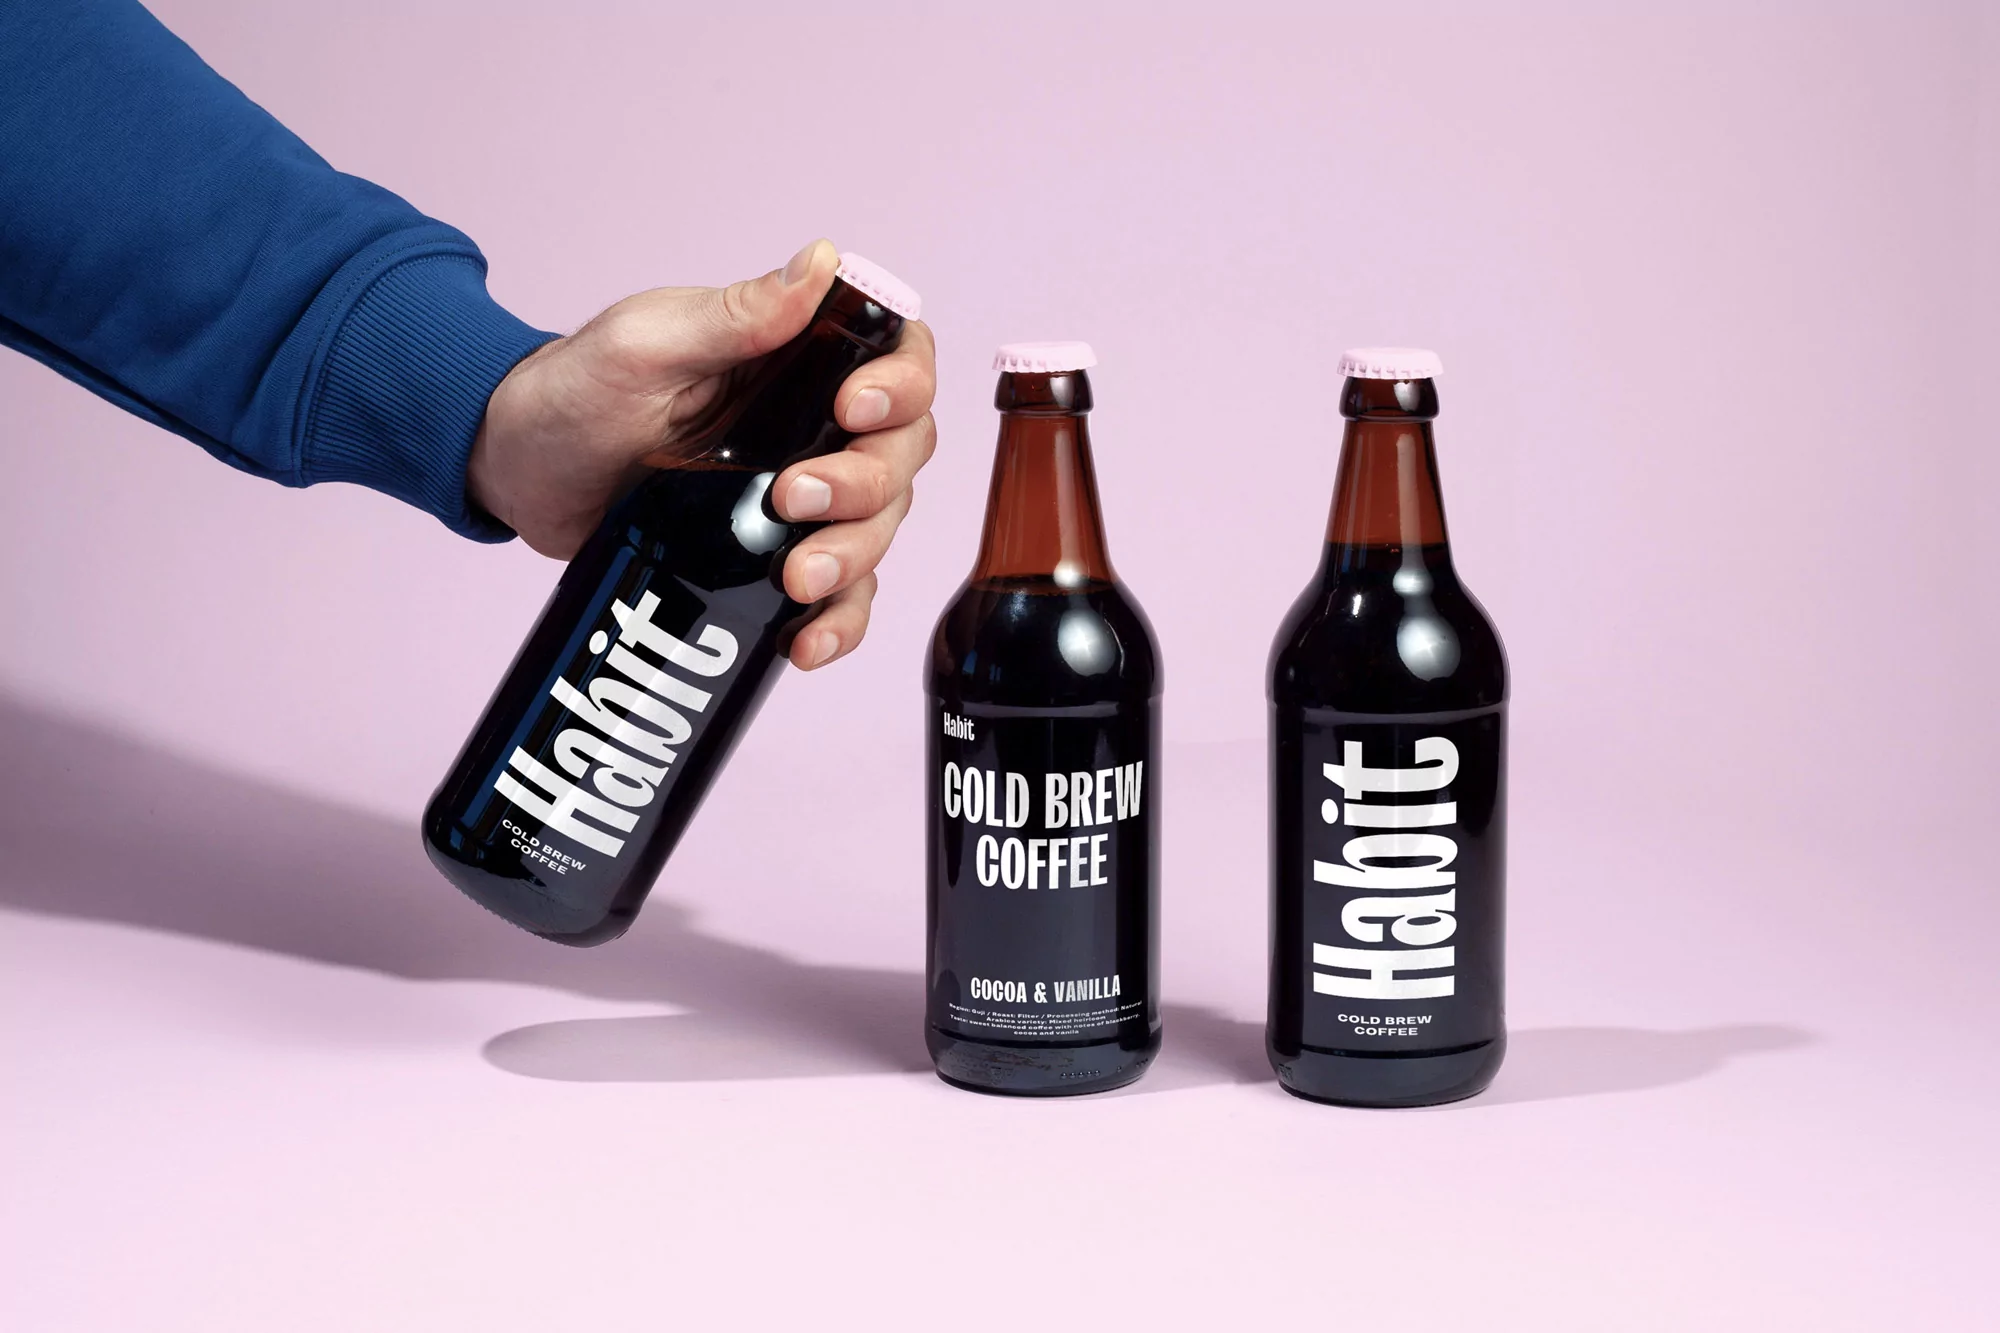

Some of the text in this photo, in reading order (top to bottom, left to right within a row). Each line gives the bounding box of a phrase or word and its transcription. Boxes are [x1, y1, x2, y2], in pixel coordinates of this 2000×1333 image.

[493, 589, 739, 858] Habit
[944, 712, 975, 741] Habit
[944, 760, 1144, 829] COLD BREW
[502, 819, 587, 871] COLD BREW
[510, 838, 568, 875] COFFEE
[976, 833, 1109, 890] COFFEE
[1313, 736, 1460, 1000] Habit
[970, 974, 1121, 1003] COCOA & VANILLA
[949, 1002, 971, 1013] Region:
[1120, 1000, 1142, 1010] Natural
[1073, 1015, 1106, 1023] heirloom
[1337, 1013, 1432, 1025] COLD BREW
[949, 1014, 969, 1023] Taste:
[991, 1022, 1026, 1030] balanced
[1354, 1026, 1418, 1036] COFFEE
